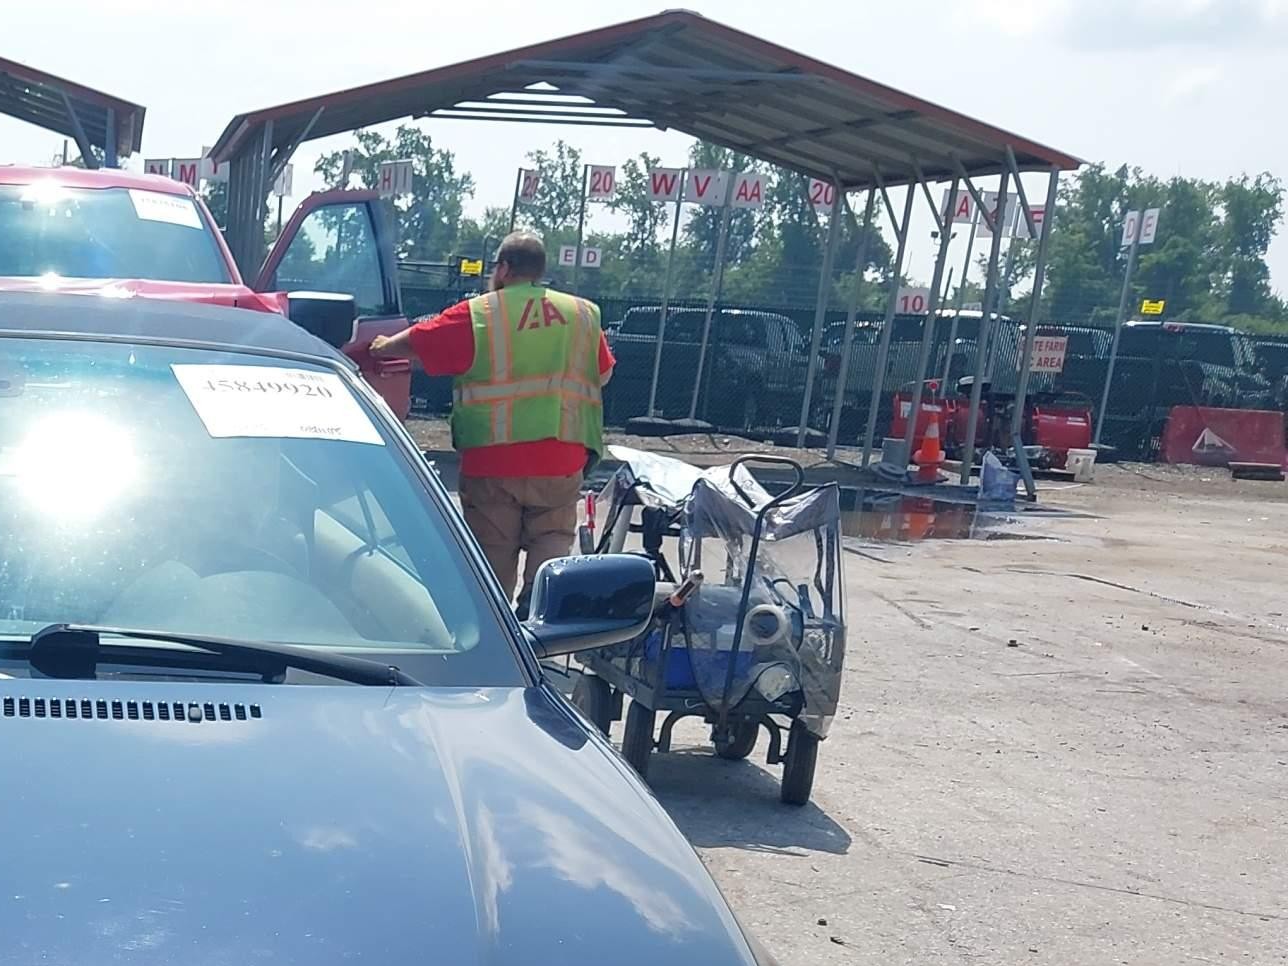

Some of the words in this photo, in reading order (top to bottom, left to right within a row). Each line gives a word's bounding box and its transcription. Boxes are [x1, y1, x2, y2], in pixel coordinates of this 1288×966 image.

[591, 171, 612, 193] 20
[651, 172, 678, 196] W
[694, 175, 712, 197] V
[735, 179, 761, 203] AA
[811, 182, 833, 205] 20
[564, 250, 574, 262] E
[586, 250, 597, 263] D
[900, 295, 924, 313] 10
[1036, 356, 1062, 368] AREA
